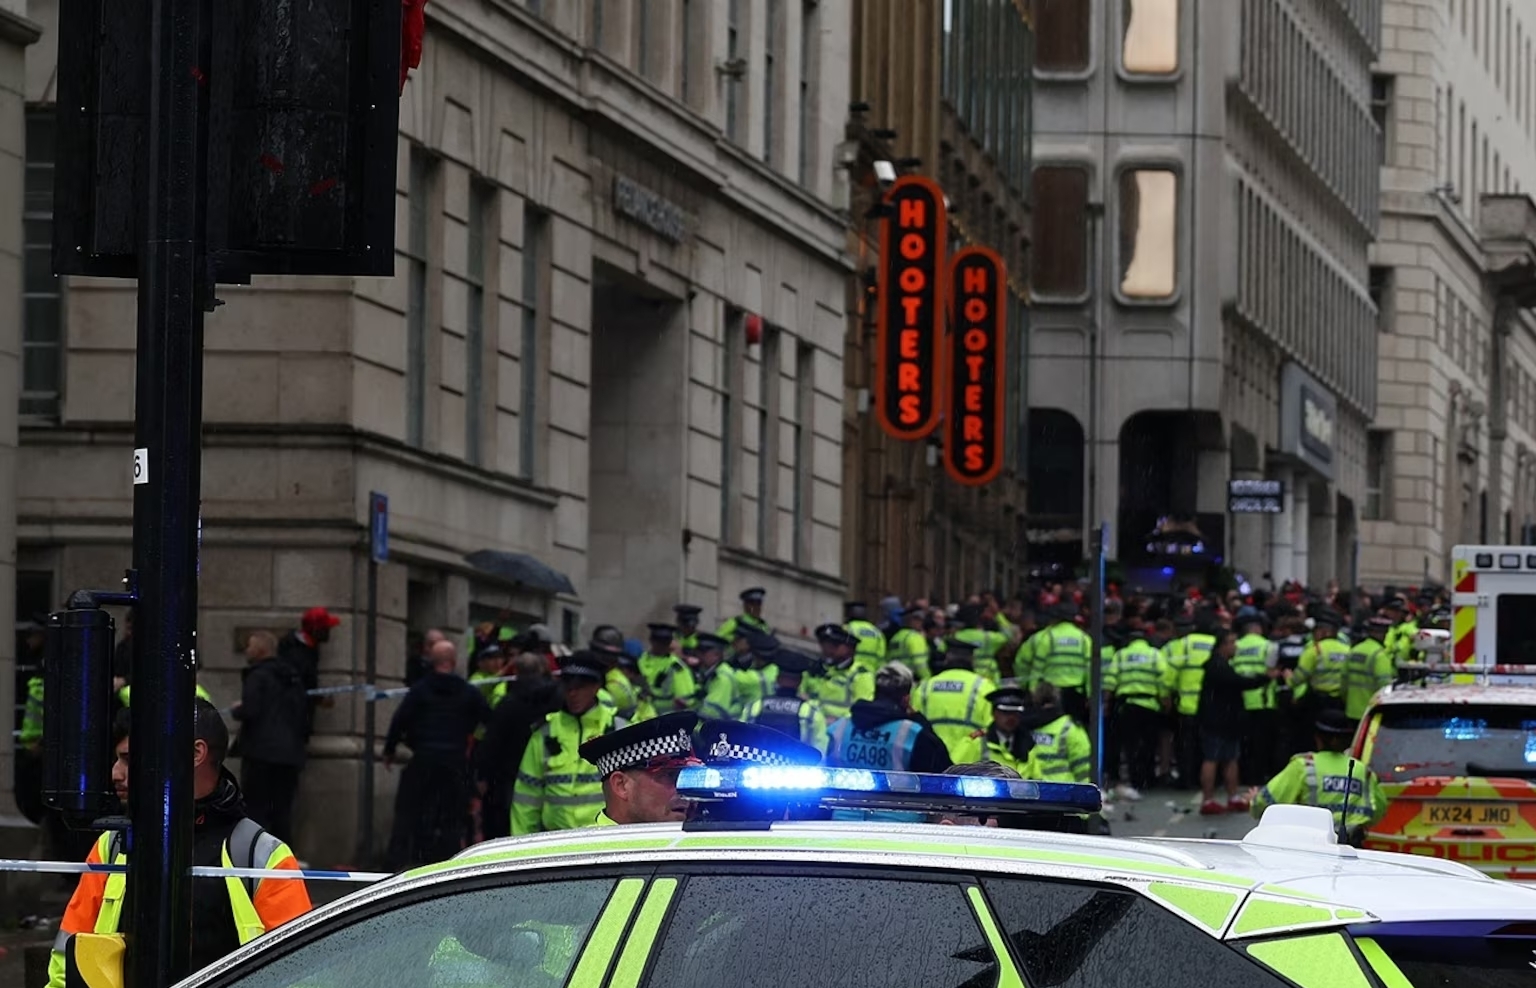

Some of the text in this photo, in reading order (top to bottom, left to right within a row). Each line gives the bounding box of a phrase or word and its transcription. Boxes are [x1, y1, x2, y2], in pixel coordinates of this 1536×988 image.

[898, 198, 927, 425] HOOTERS
[963, 265, 989, 472] HOOTERS
[846, 744, 888, 768] GA98
[1429, 804, 1511, 824] KX24 JMO
